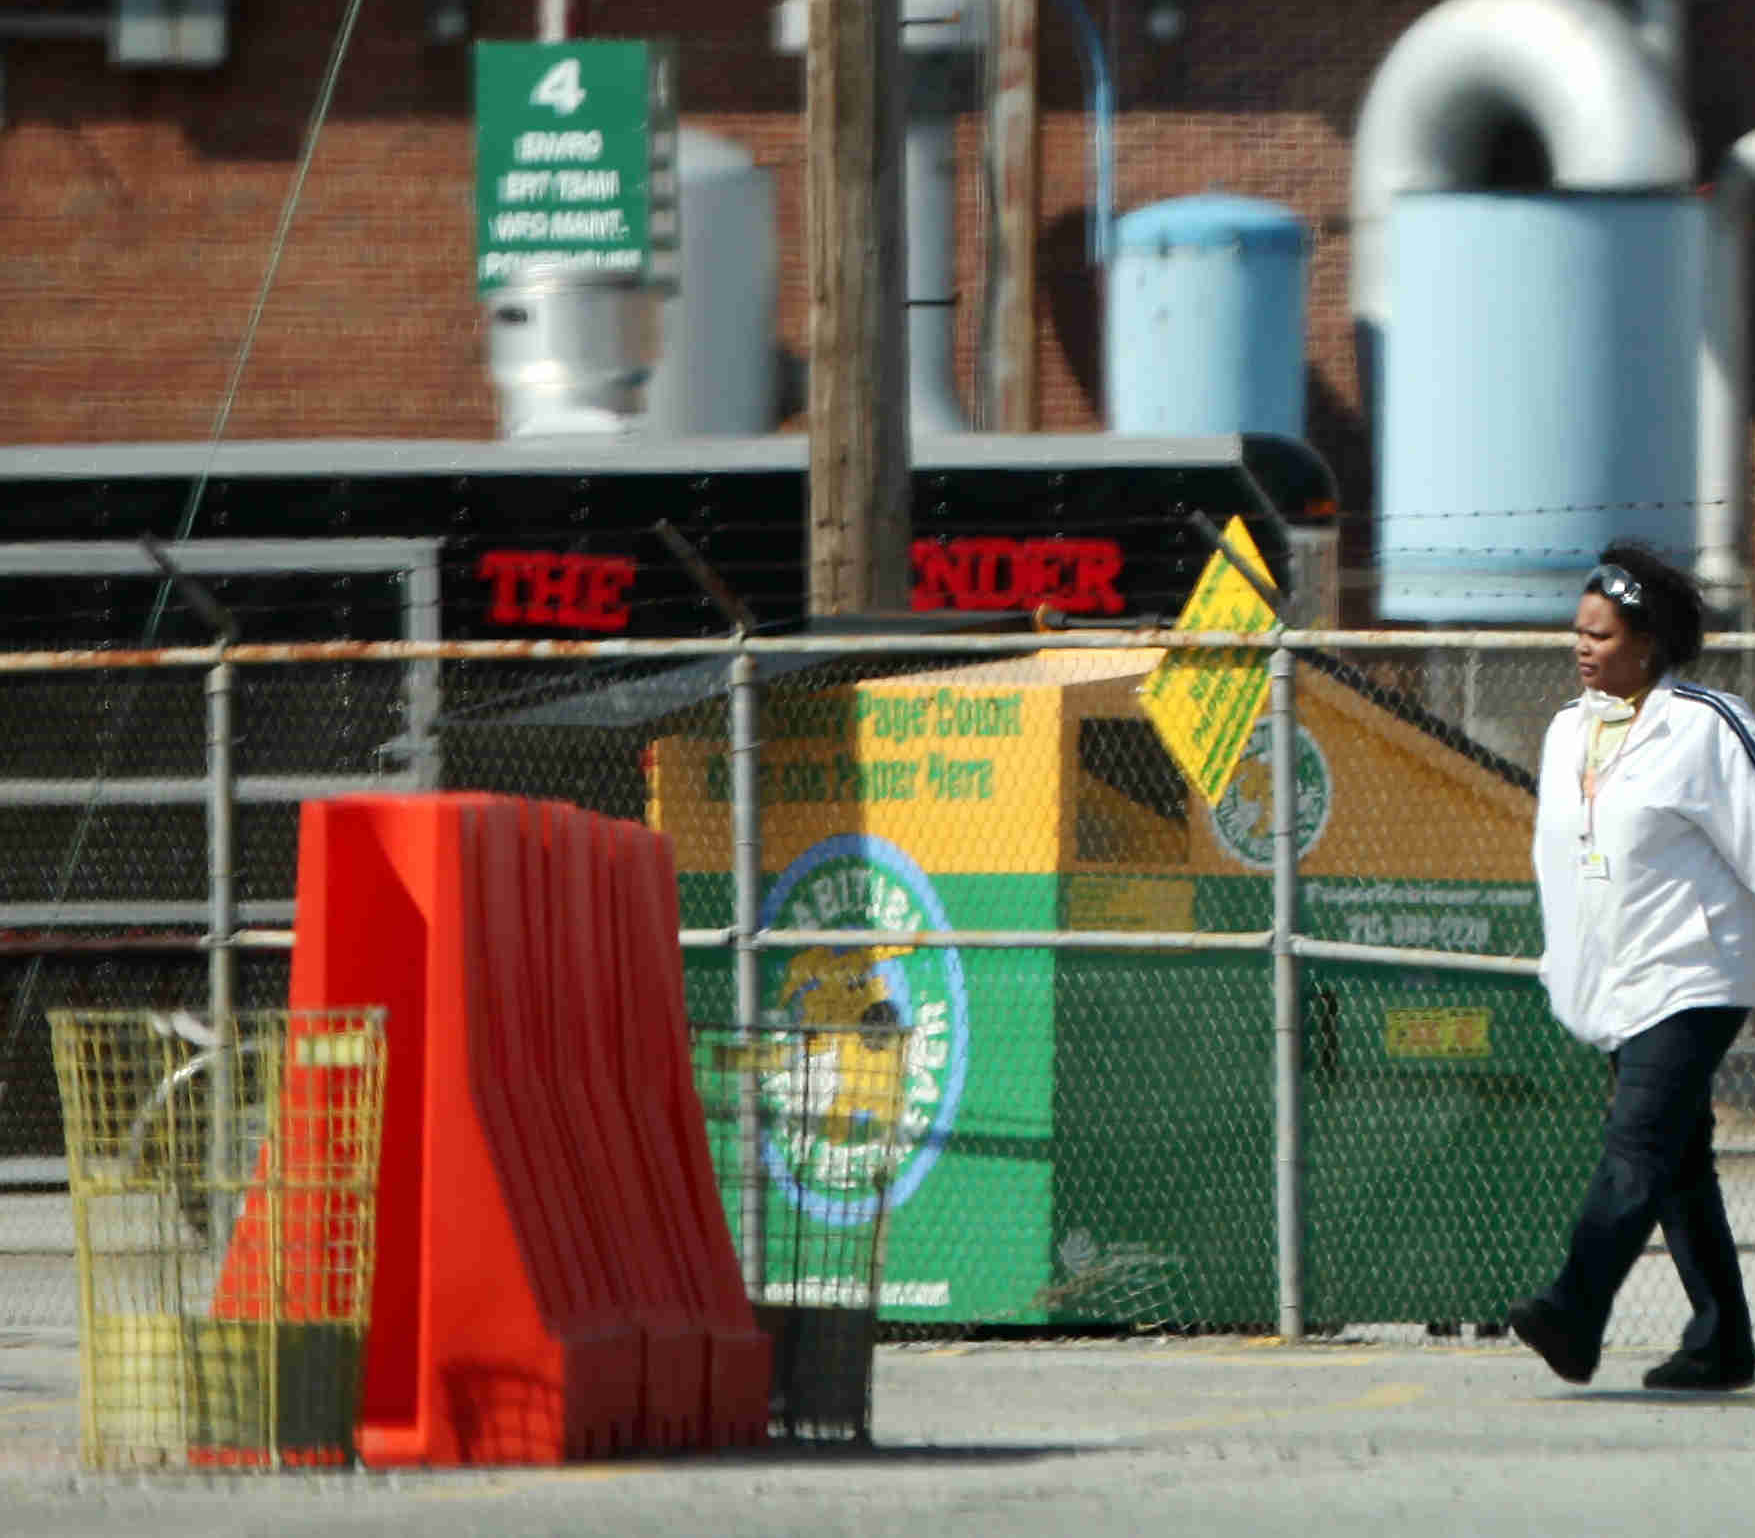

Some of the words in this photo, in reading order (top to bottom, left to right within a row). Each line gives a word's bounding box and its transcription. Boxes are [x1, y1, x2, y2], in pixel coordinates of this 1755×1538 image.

[528, 58, 587, 116] 4
[478, 549, 636, 630] THE
[907, 536, 1126, 613] NDER
[855, 690, 930, 743] Page
